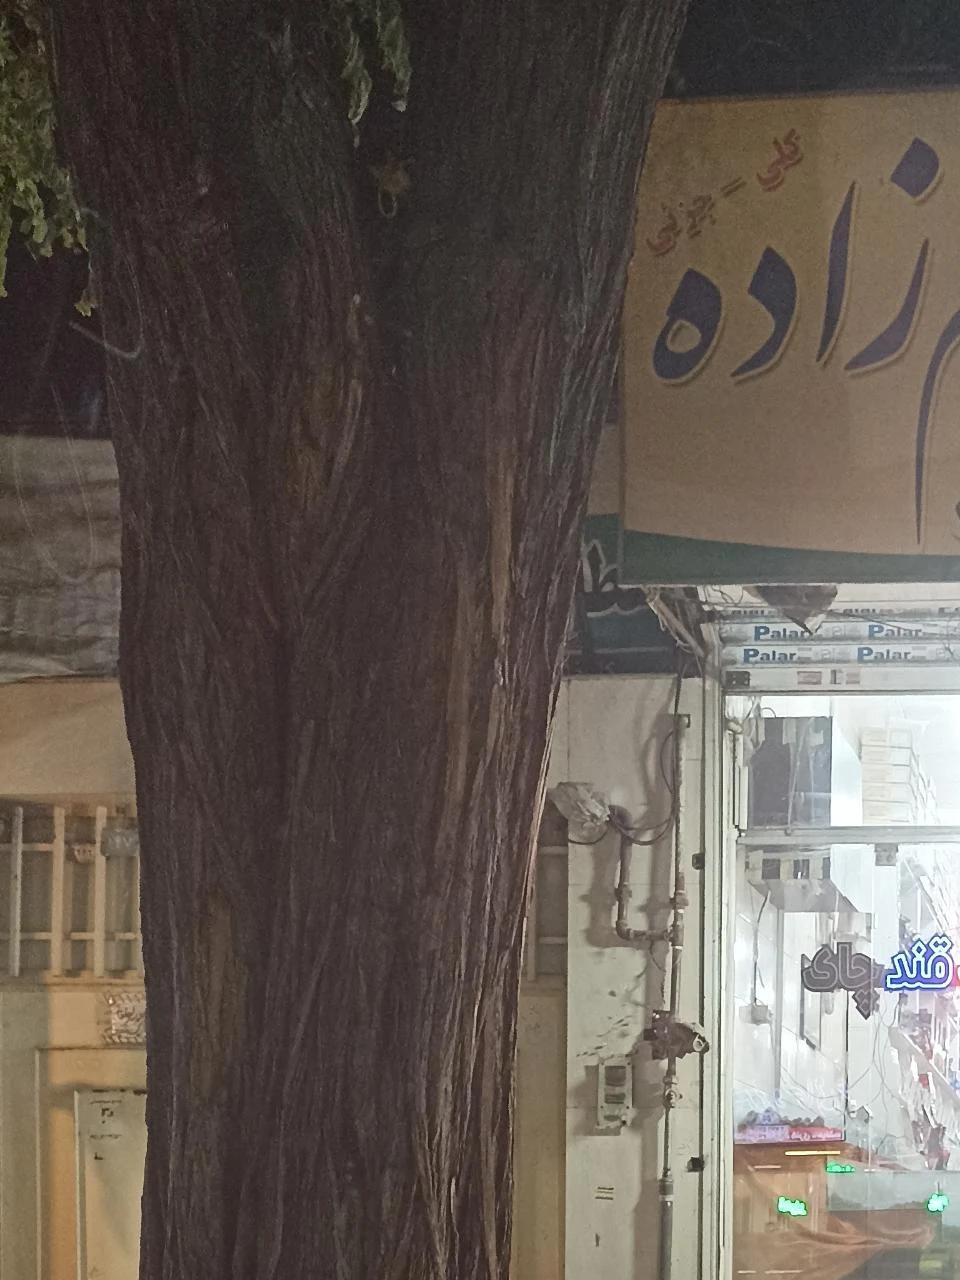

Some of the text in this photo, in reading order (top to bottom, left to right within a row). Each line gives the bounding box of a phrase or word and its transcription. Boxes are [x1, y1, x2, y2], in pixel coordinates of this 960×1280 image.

[651, 136, 941, 385] زاده
[743, 648, 797, 663] Palar
[857, 646, 911, 662] Palar
[868, 624, 922, 639] Palar
[801, 942, 882, 1019] چای
[885, 934, 953, 990] قند
